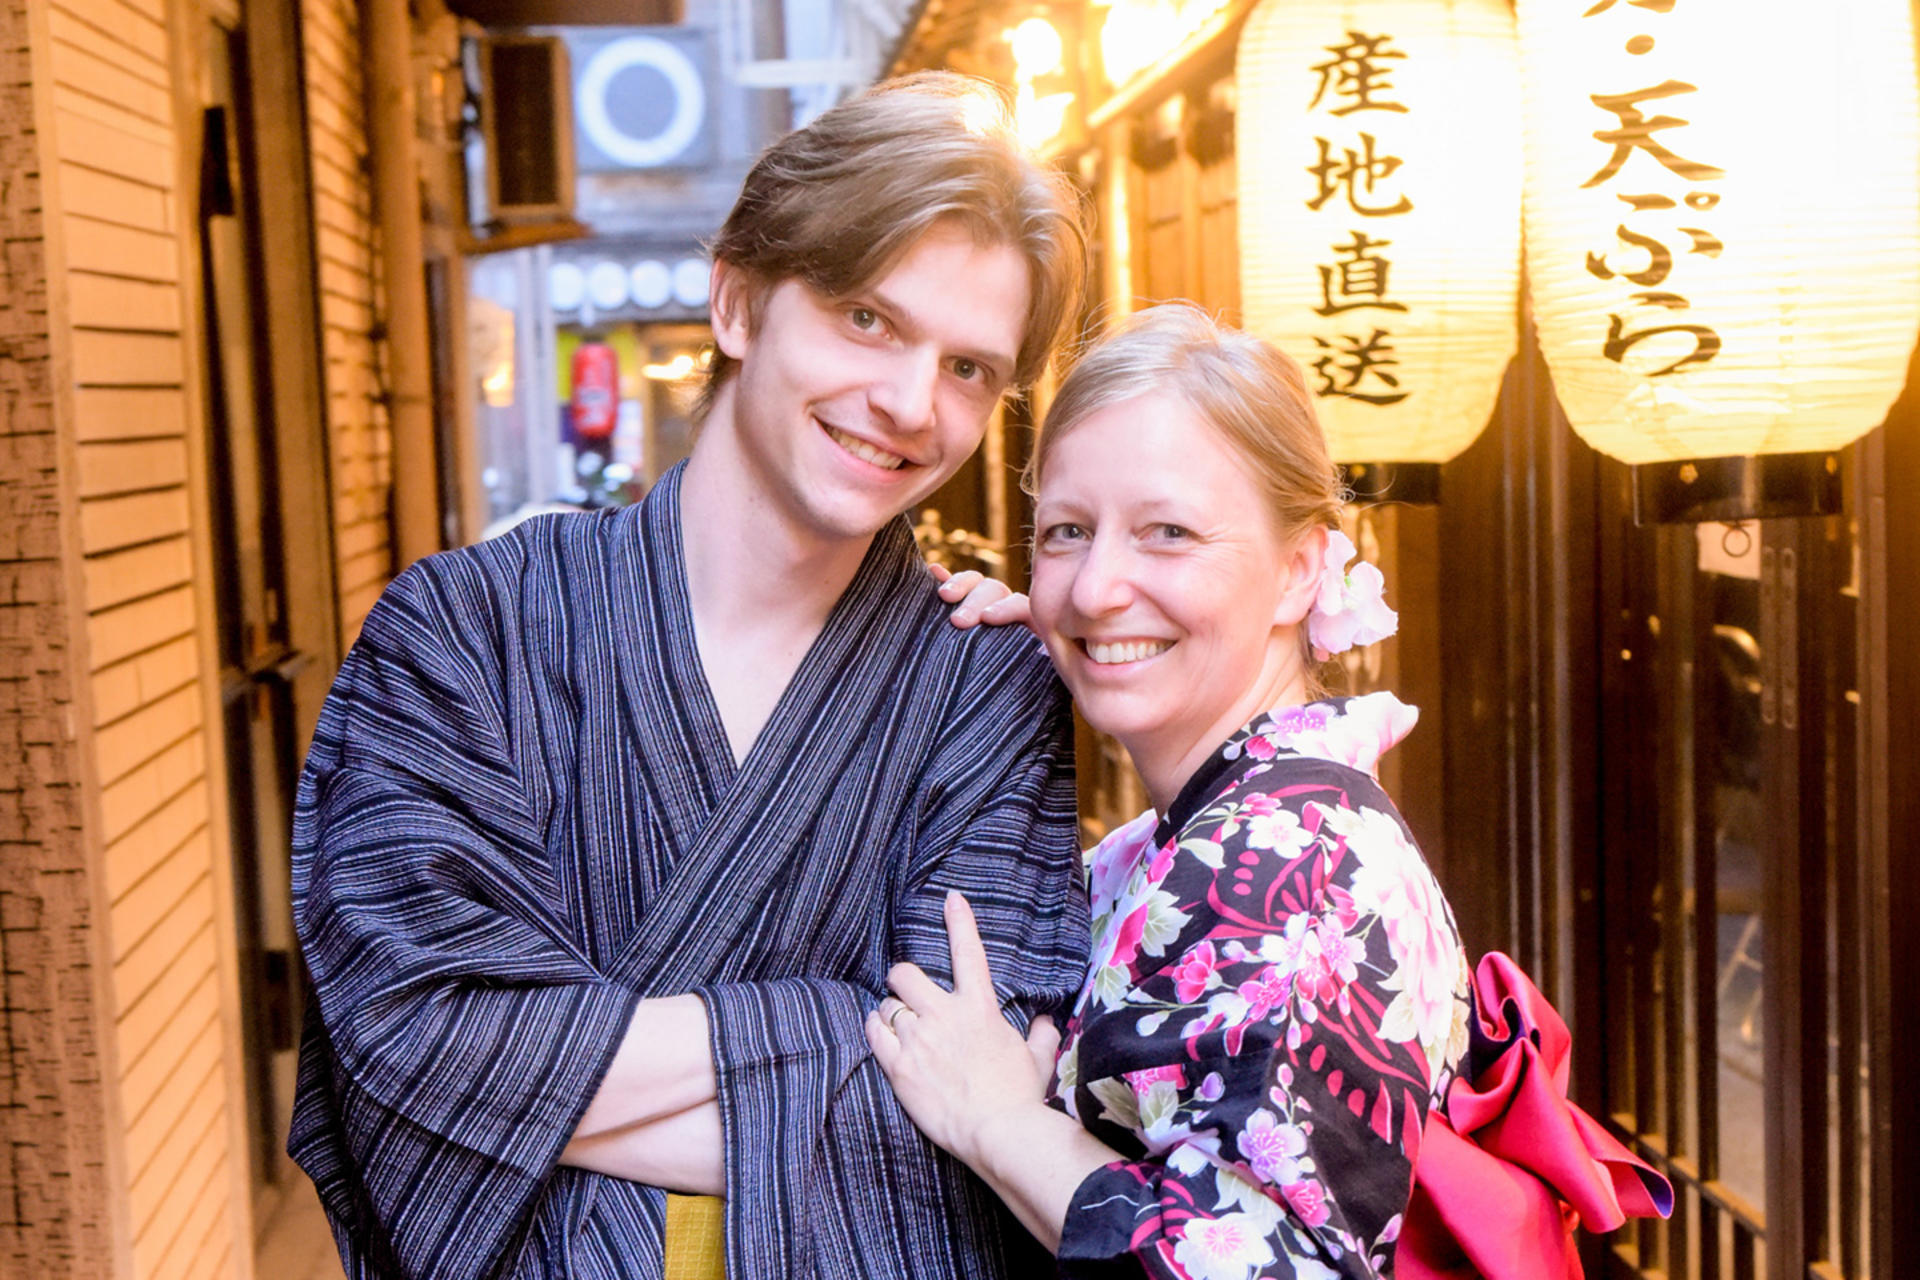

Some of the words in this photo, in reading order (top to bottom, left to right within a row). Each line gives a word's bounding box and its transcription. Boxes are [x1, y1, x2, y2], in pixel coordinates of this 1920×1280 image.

[1305, 28, 1414, 407] 産地直送
[1579, 0, 1724, 379] ・天ぷら
